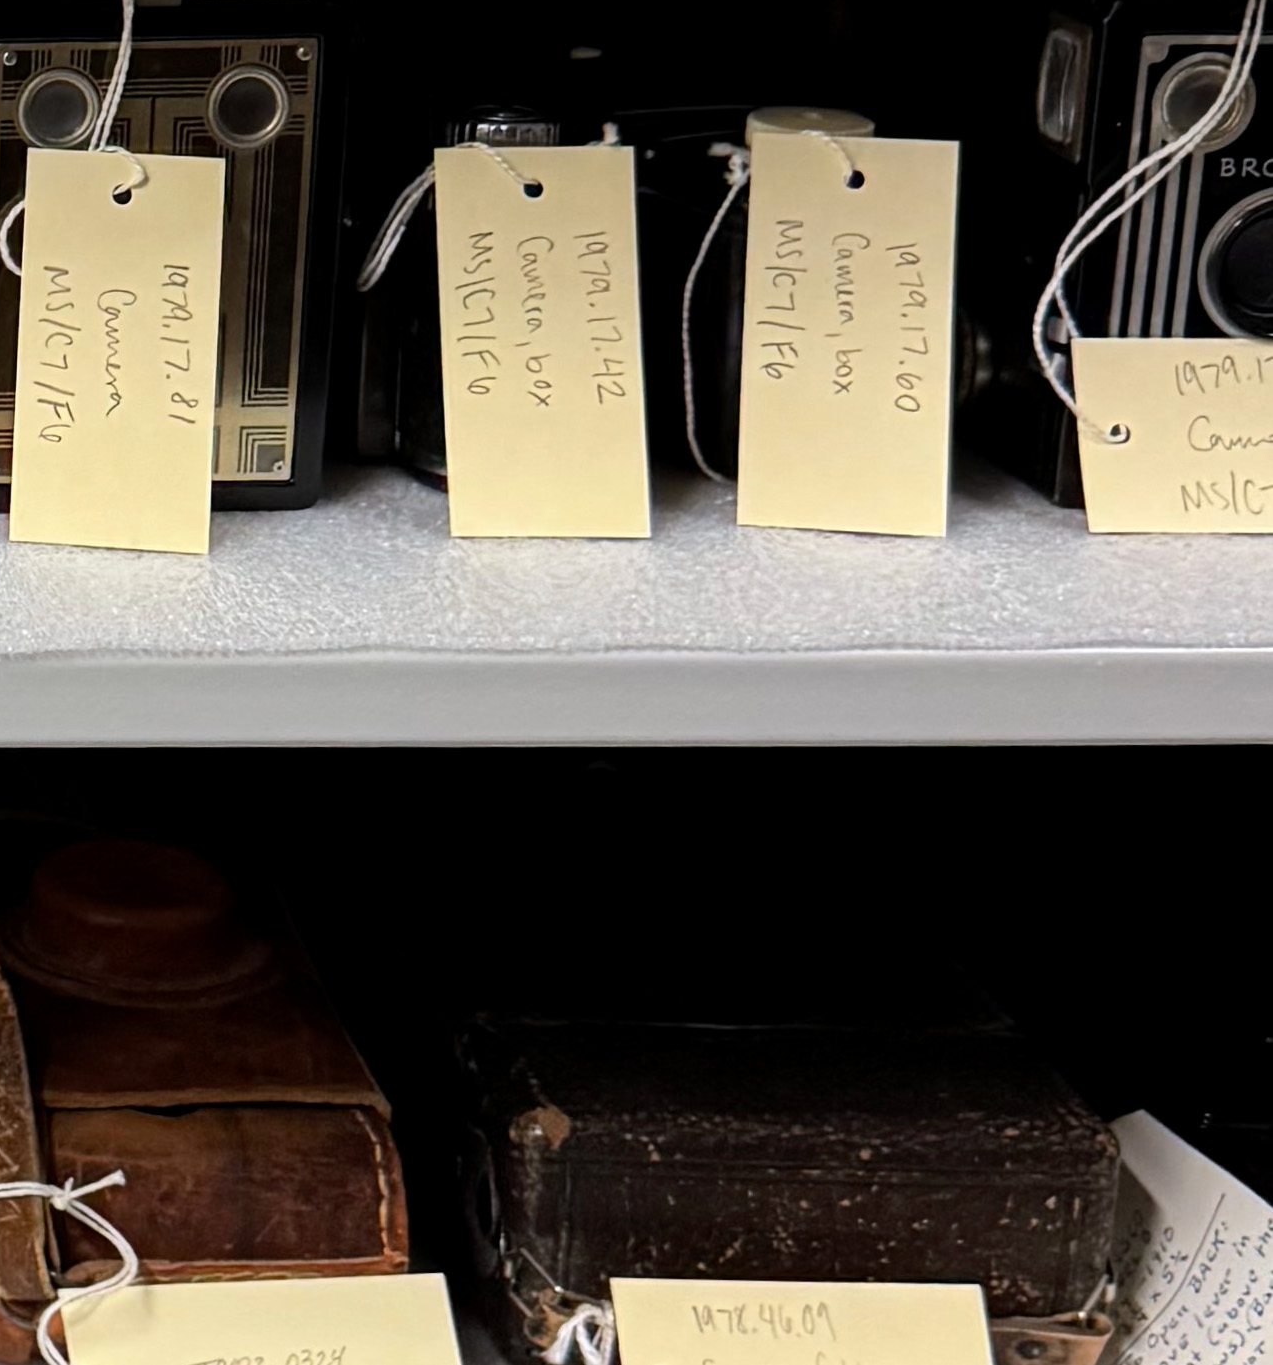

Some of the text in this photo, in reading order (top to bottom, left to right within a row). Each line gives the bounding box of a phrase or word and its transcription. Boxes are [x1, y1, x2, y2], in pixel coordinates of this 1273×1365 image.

[37, 265, 81, 443] MS/C7/F6
[97, 289, 136, 417] Camera
[161, 264, 199, 424] 1979.17.81
[456, 232, 500, 395] MS/C7/F6
[573, 232, 625, 404] 1979.17.42
[757, 220, 806, 380] MS/C7/F6
[831, 349, 863, 395] box
[885, 243, 930, 414] 1979.17.60
[525, 355, 553, 407] box
[691, 1301, 836, 1341] 1978.46.09
